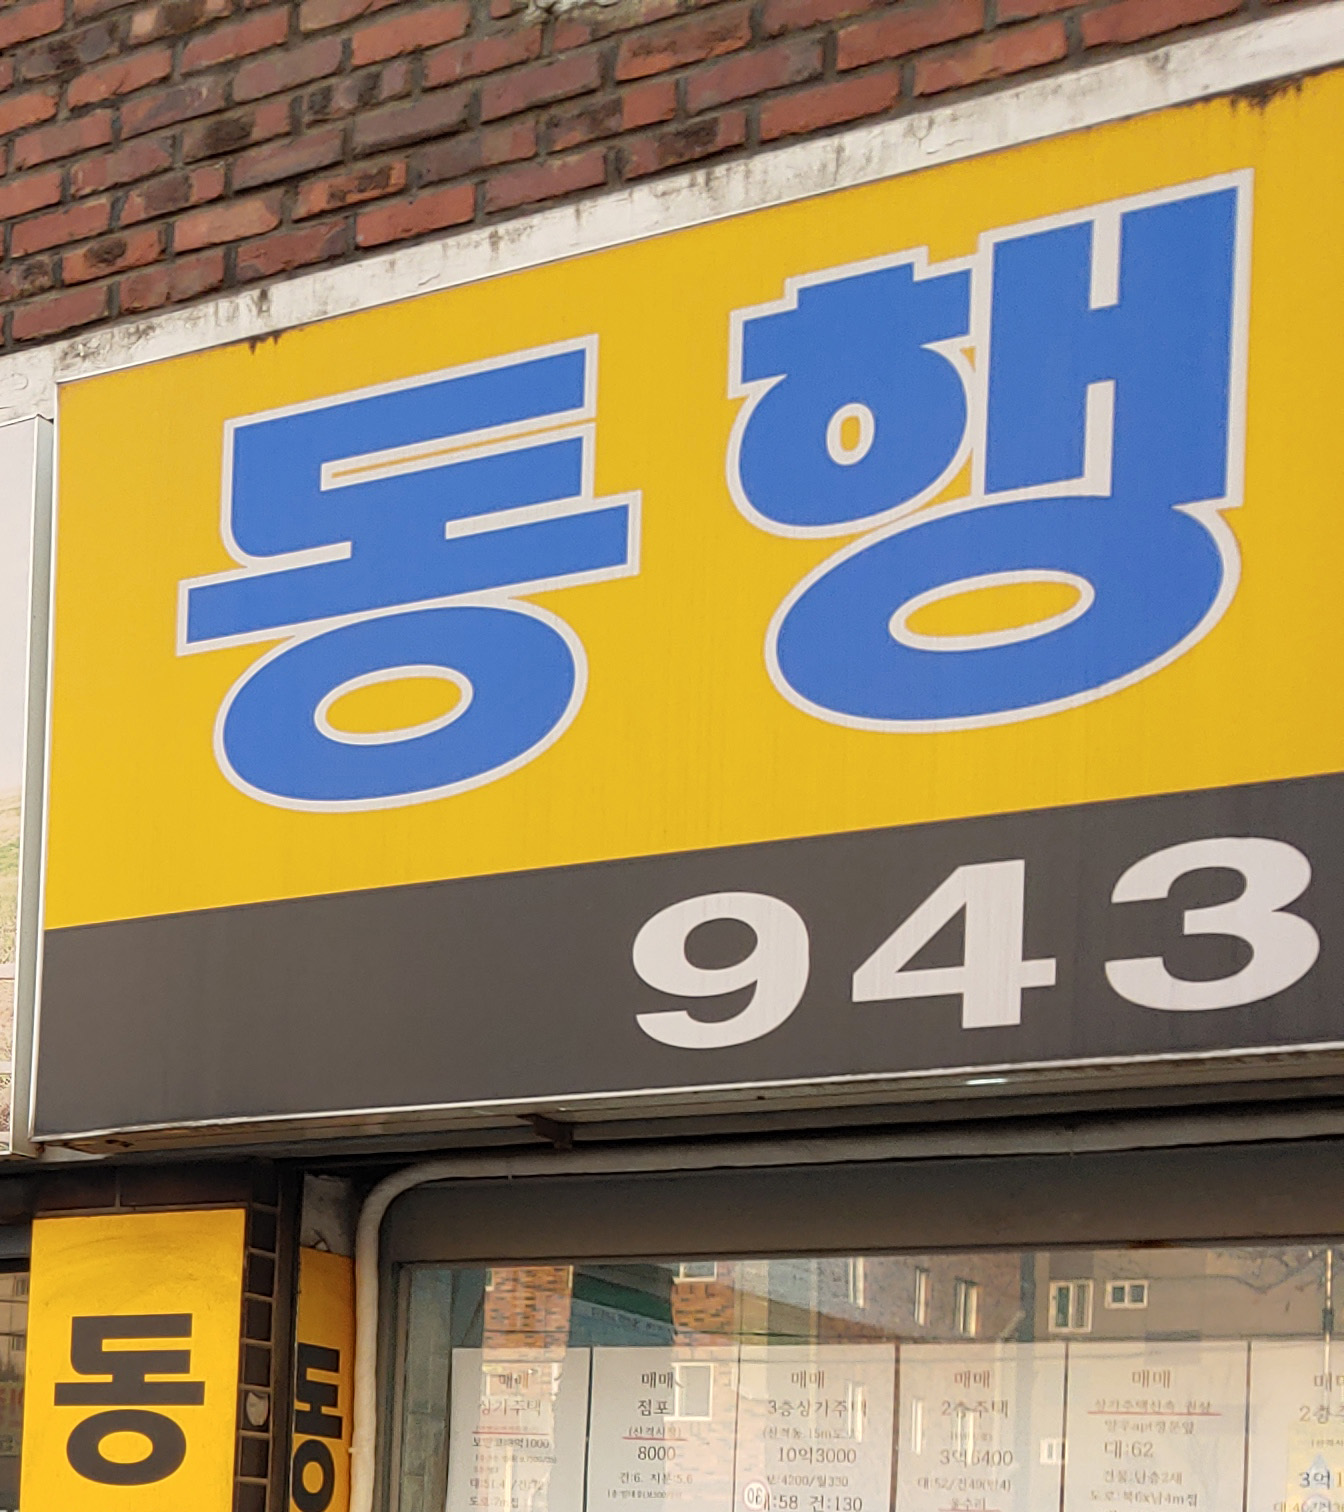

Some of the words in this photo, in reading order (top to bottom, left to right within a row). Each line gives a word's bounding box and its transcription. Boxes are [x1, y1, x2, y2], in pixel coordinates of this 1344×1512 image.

[174, 168, 1255, 814] 동행
[631, 835, 1322, 1051] 943
[641, 1371, 674, 1389] 매매
[791, 1370, 825, 1389] 매매
[954, 1370, 991, 1389] 매매
[1131, 1369, 1171, 1389] 매매
[637, 1399, 675, 1417] 점포
[637, 1446, 677, 1461] 8000
[777, 1446, 858, 1465] 10억3000
